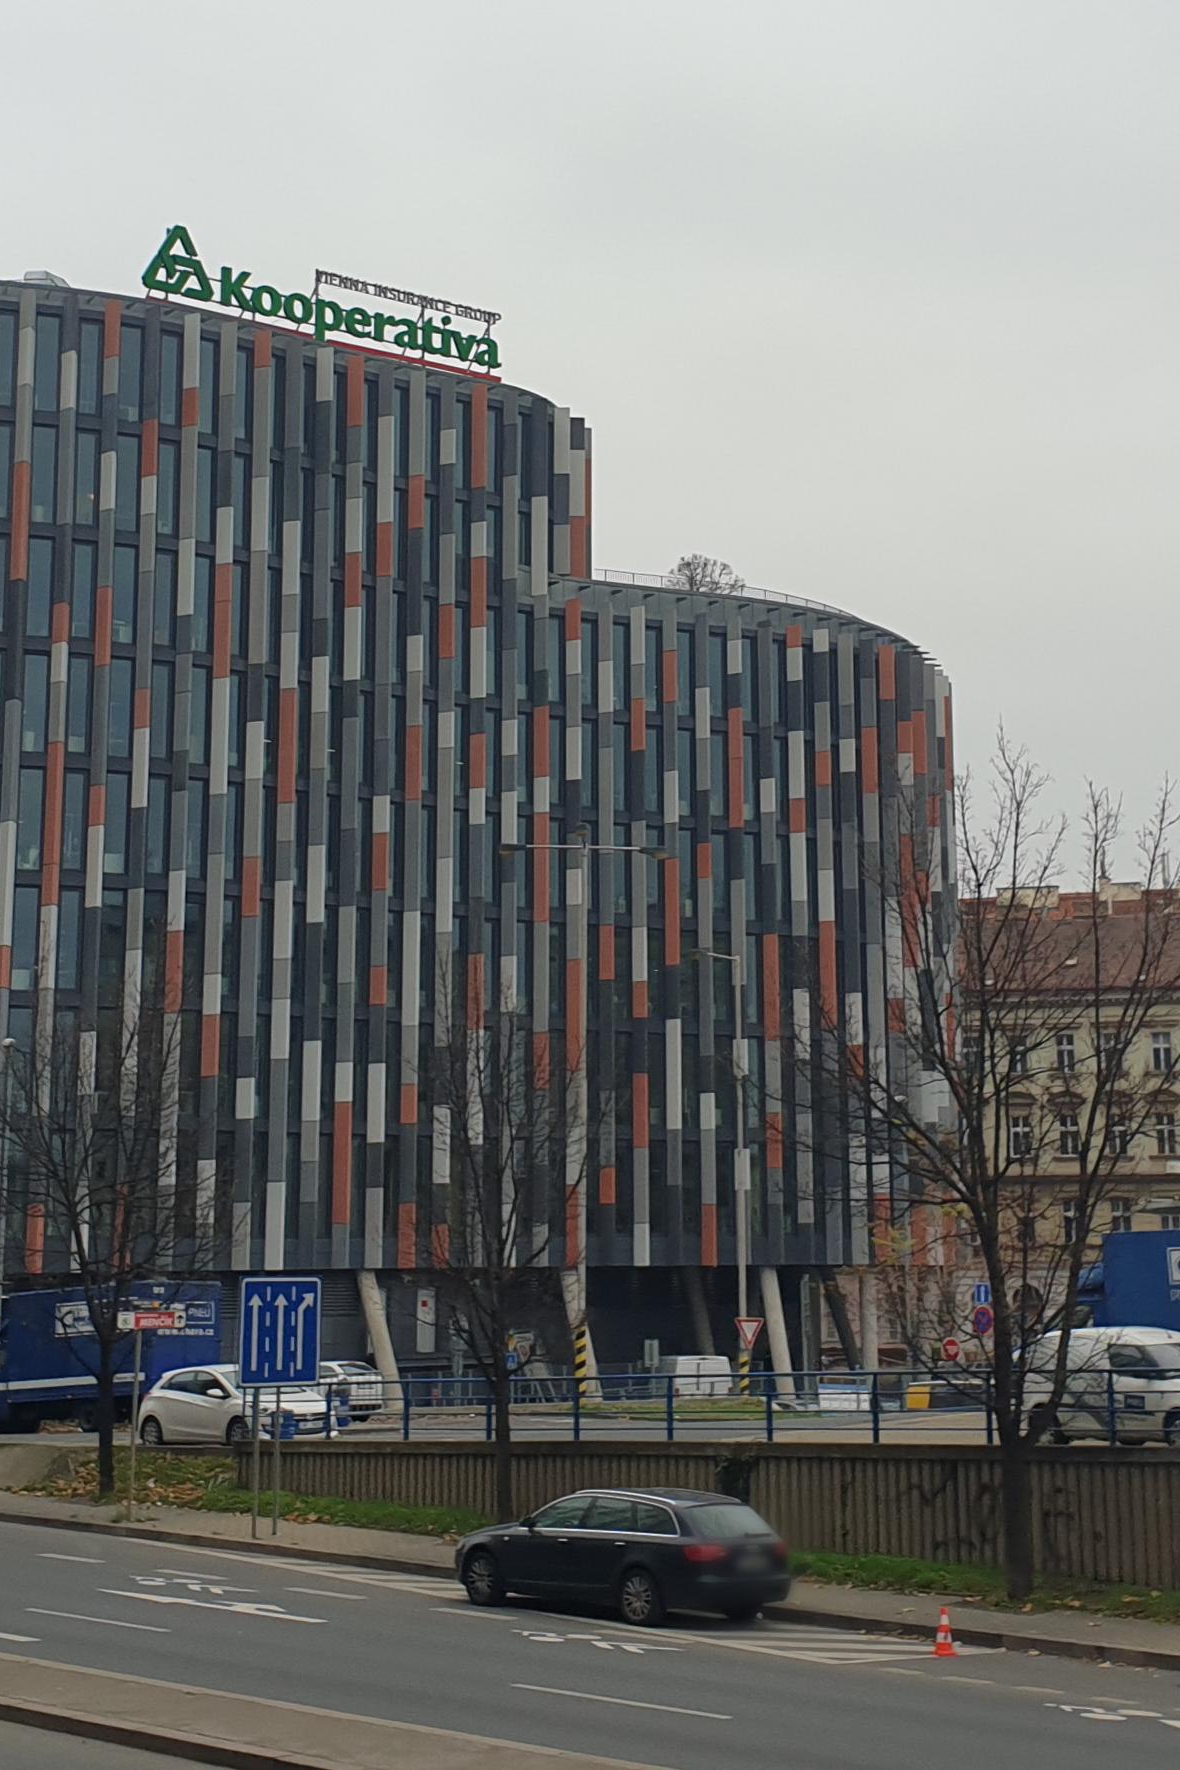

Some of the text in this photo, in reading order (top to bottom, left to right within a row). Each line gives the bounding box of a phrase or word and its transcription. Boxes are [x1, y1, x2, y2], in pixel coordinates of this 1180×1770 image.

[220, 266, 502, 369] Kooperativa
[316, 270, 502, 325] VIENNA INSURANCE GROUP
